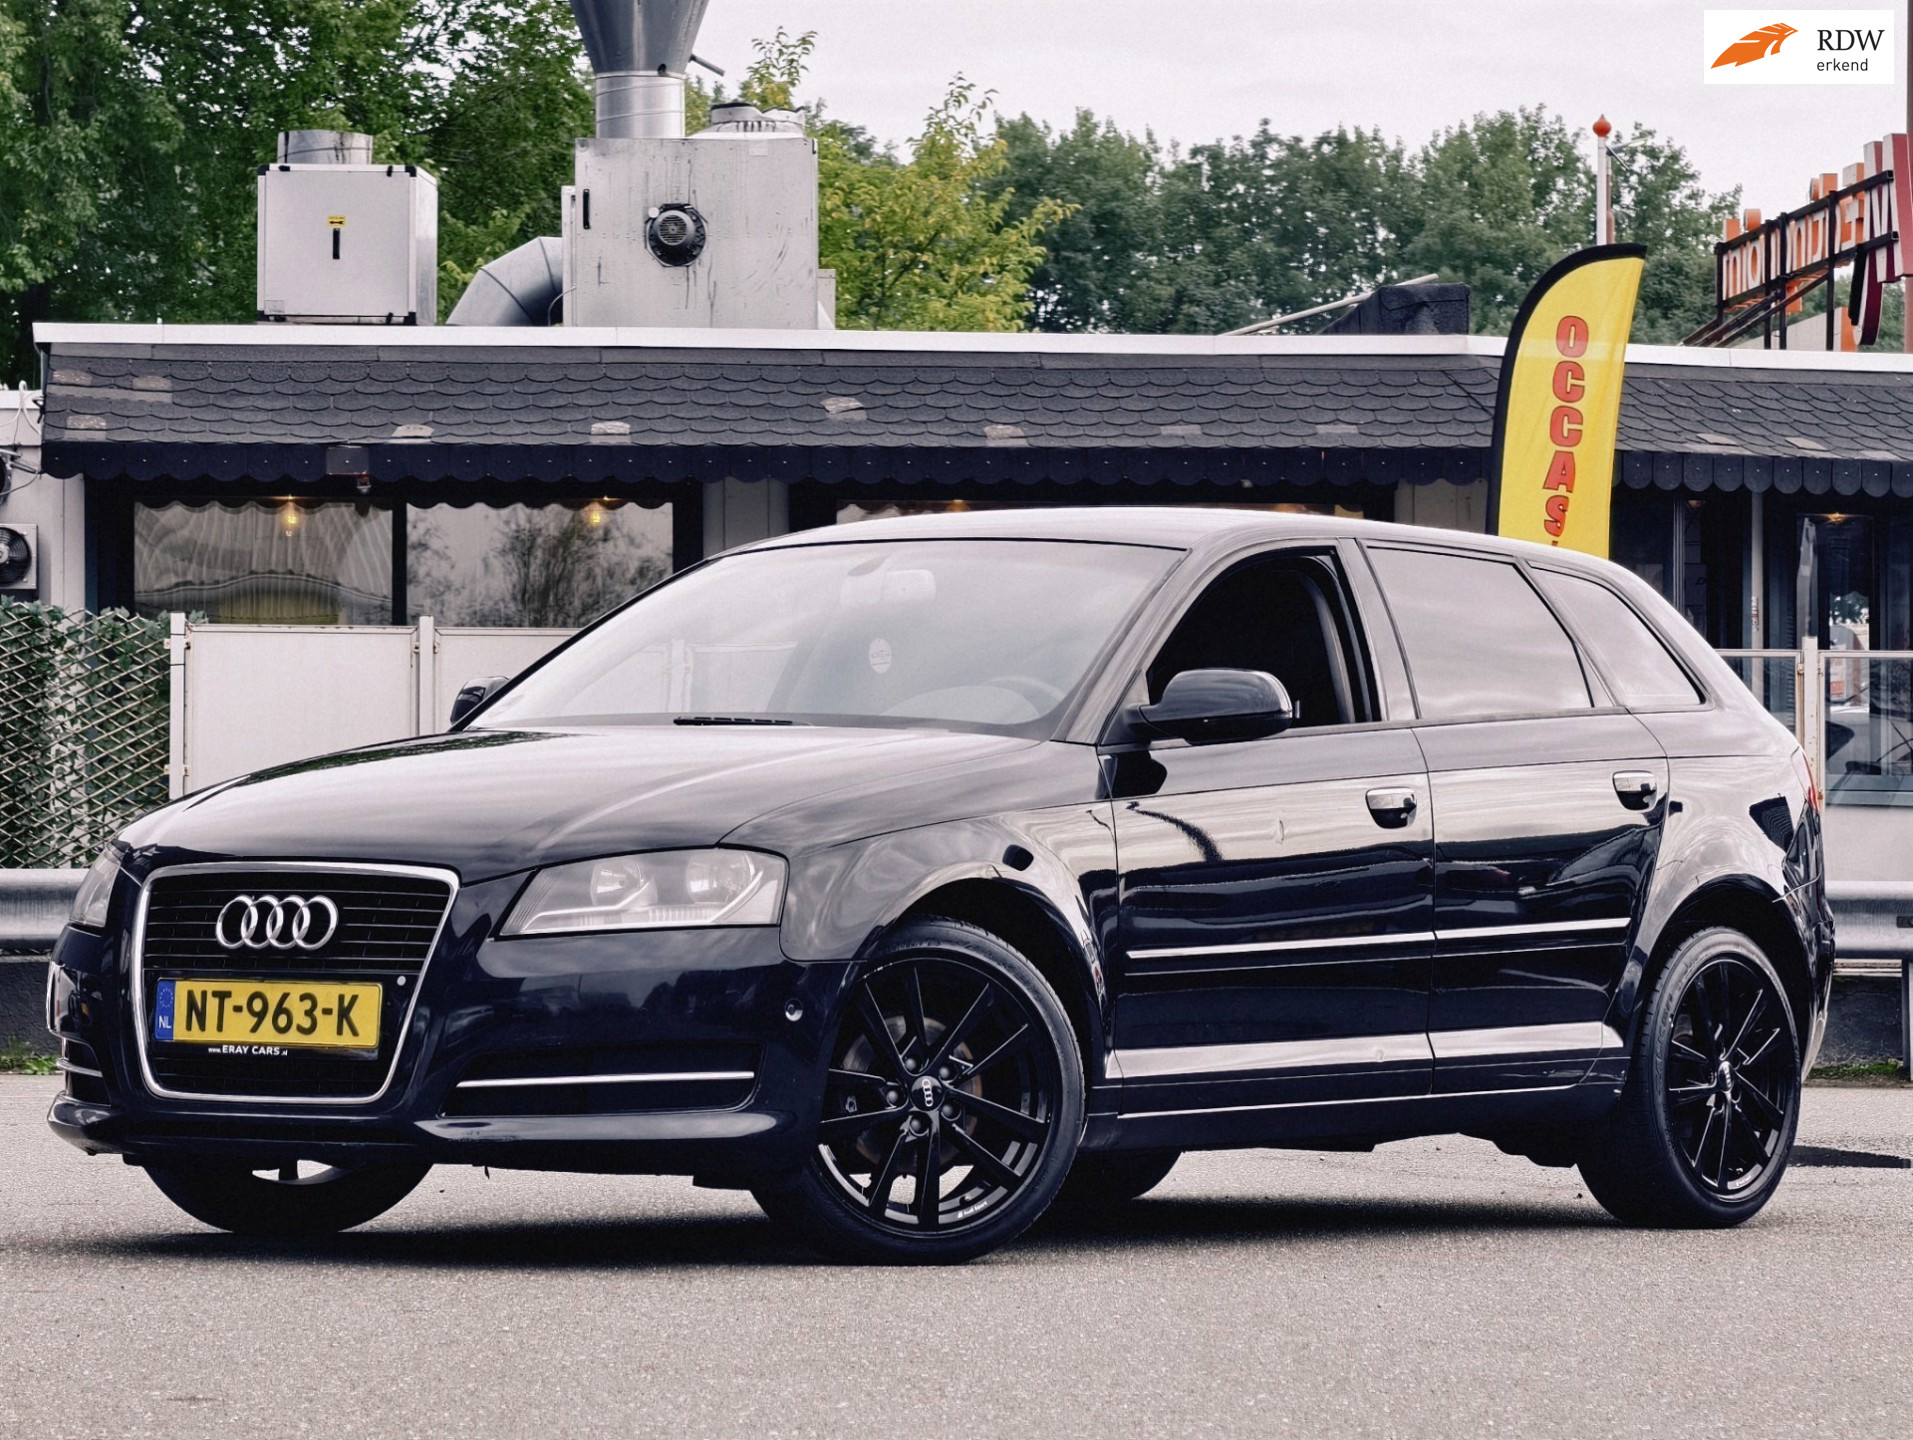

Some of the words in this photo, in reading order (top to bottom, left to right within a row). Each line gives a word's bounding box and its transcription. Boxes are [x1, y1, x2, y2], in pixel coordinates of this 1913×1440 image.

[1541, 315, 1590, 546] OCCAS
[158, 1016, 172, 1029] NL
[185, 989, 360, 1037] NT-963-K
